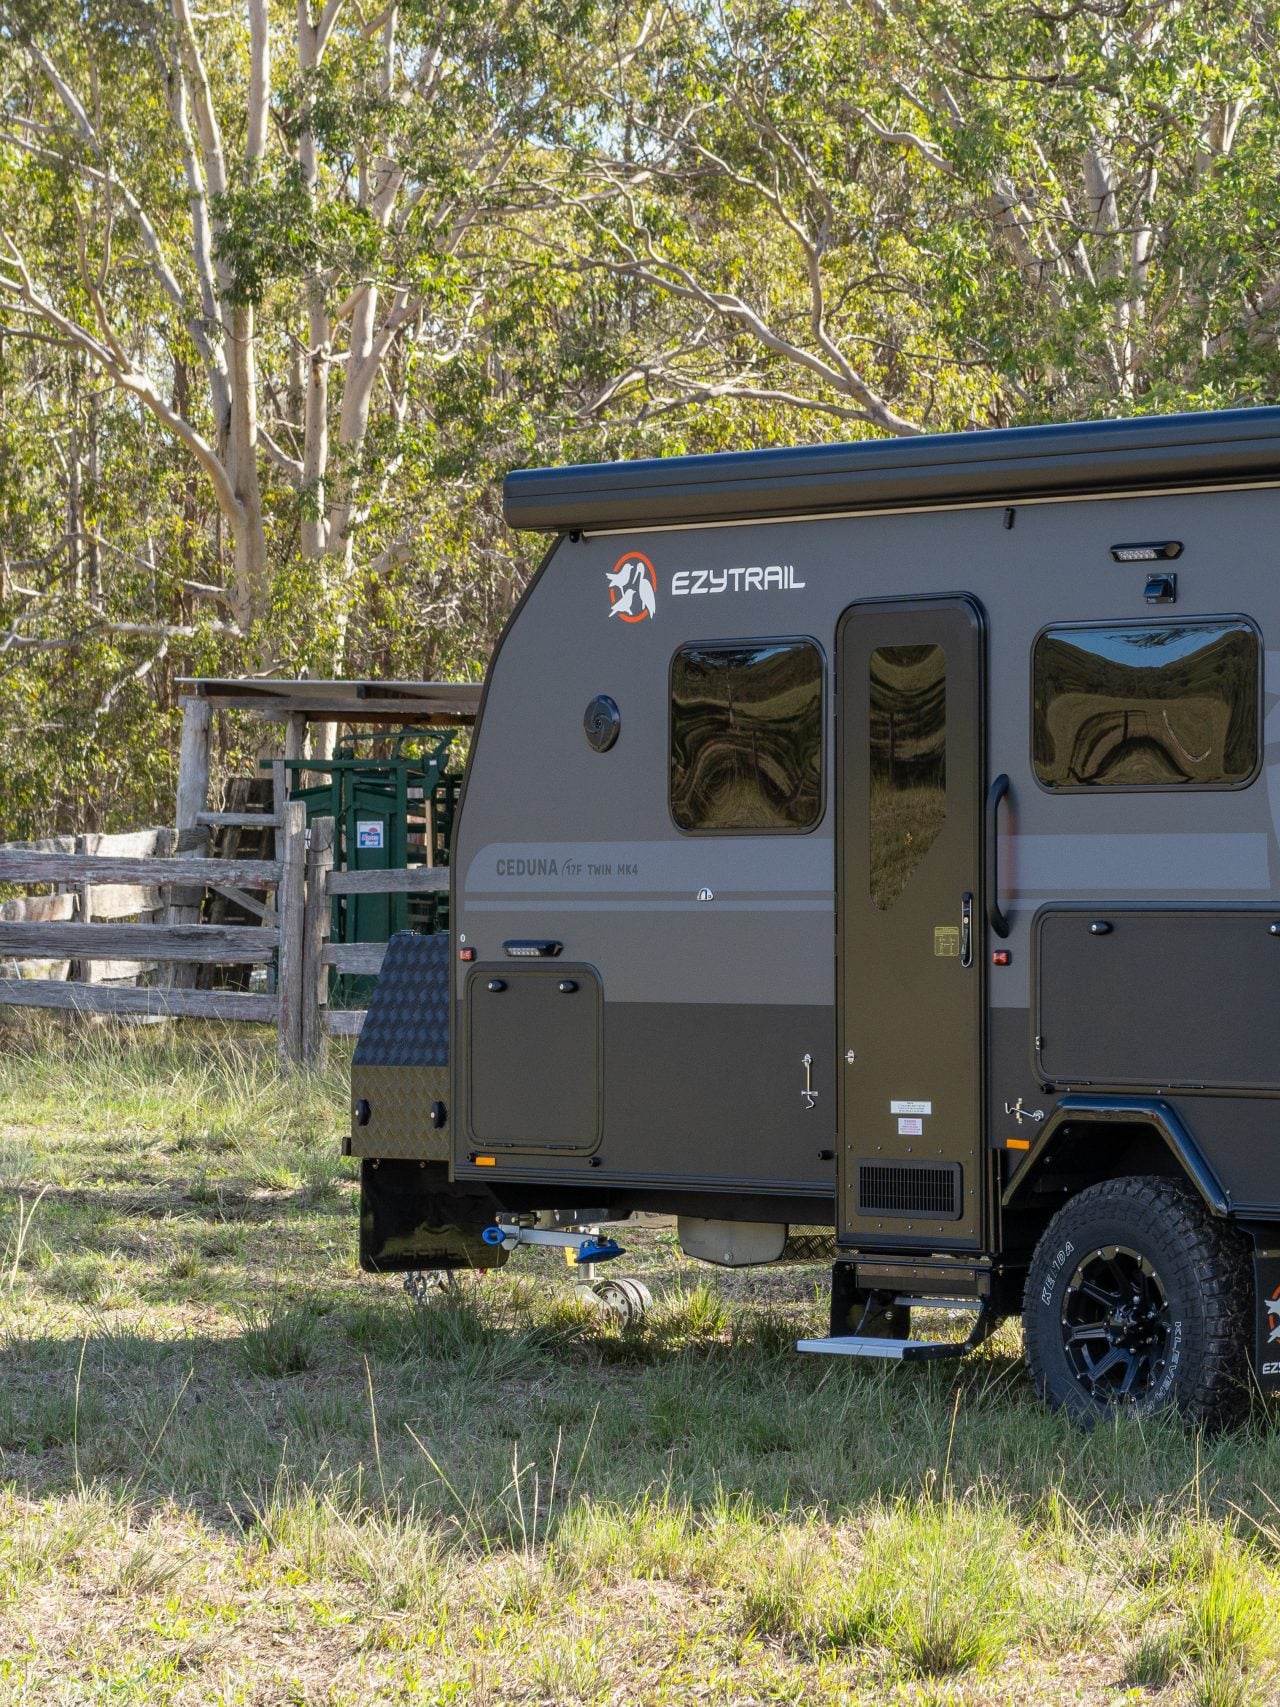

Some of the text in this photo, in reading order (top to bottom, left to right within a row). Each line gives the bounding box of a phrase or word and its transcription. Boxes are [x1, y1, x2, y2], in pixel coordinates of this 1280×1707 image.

[671, 564, 807, 596] EZYTRAIL
[496, 858, 559, 876] CEDUNA
[587, 864, 612, 875] TWIN
[617, 863, 639, 875] MK4
[1041, 1241, 1075, 1306] KENDA
